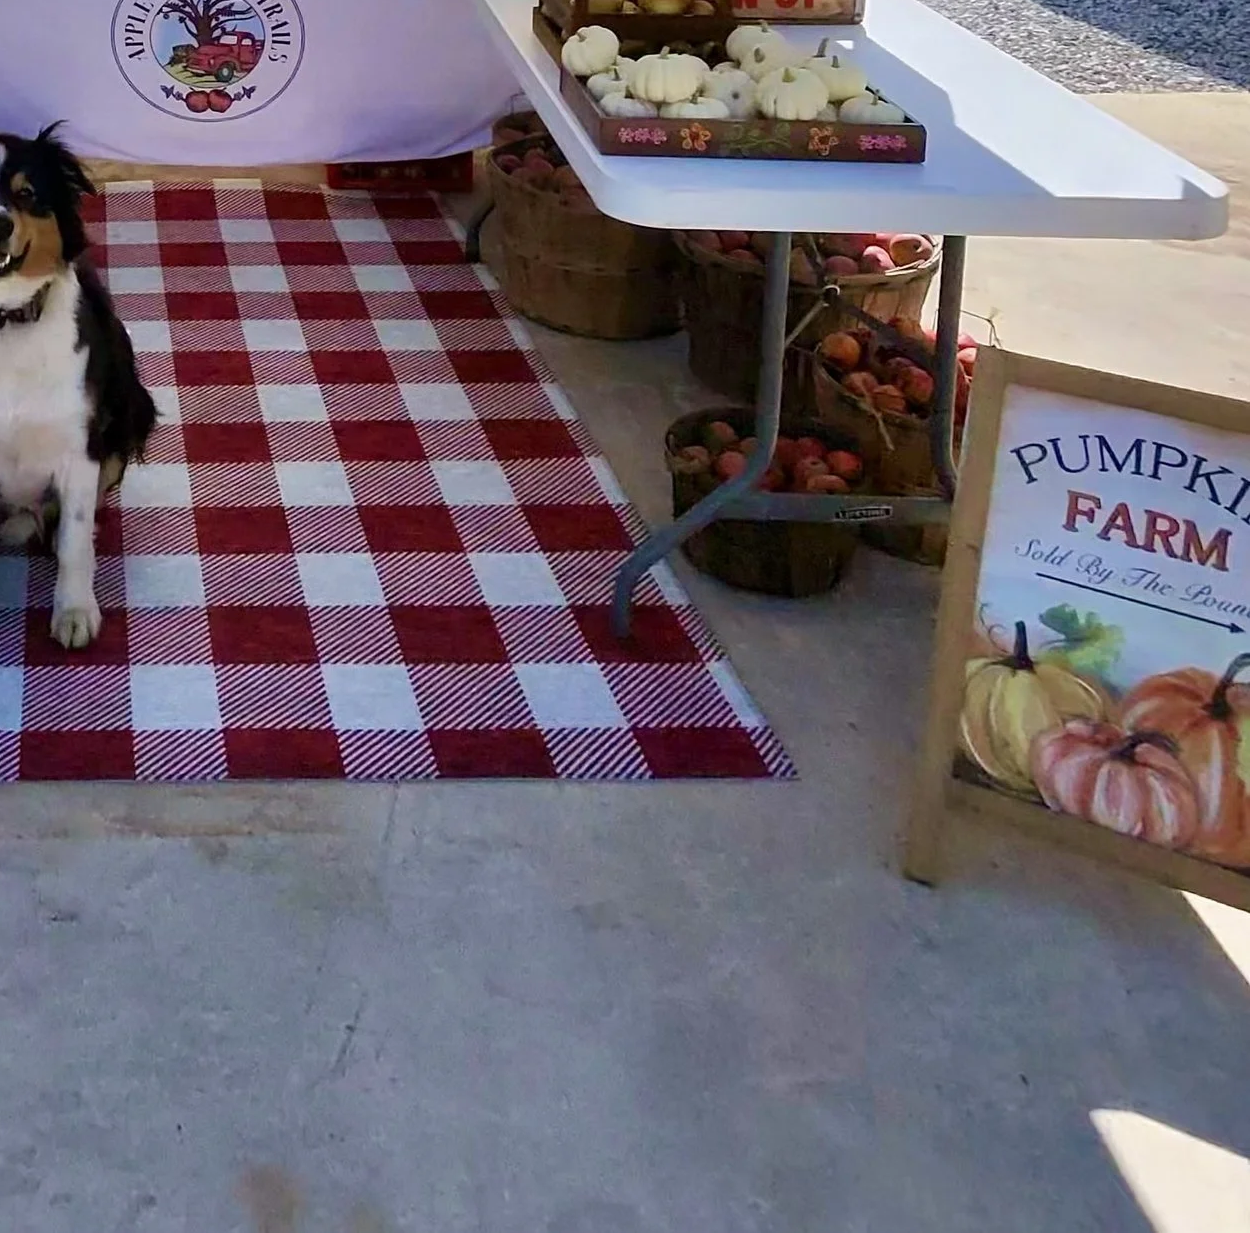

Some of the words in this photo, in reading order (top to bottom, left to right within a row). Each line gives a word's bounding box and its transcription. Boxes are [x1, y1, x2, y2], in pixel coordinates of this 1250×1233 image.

[1010, 434, 1250, 527] PUMPKI
[1015, 538, 1074, 568] Sold
[1076, 553, 1117, 585] By
[1122, 566, 1175, 597] The
[1062, 489, 1233, 572] FARM
